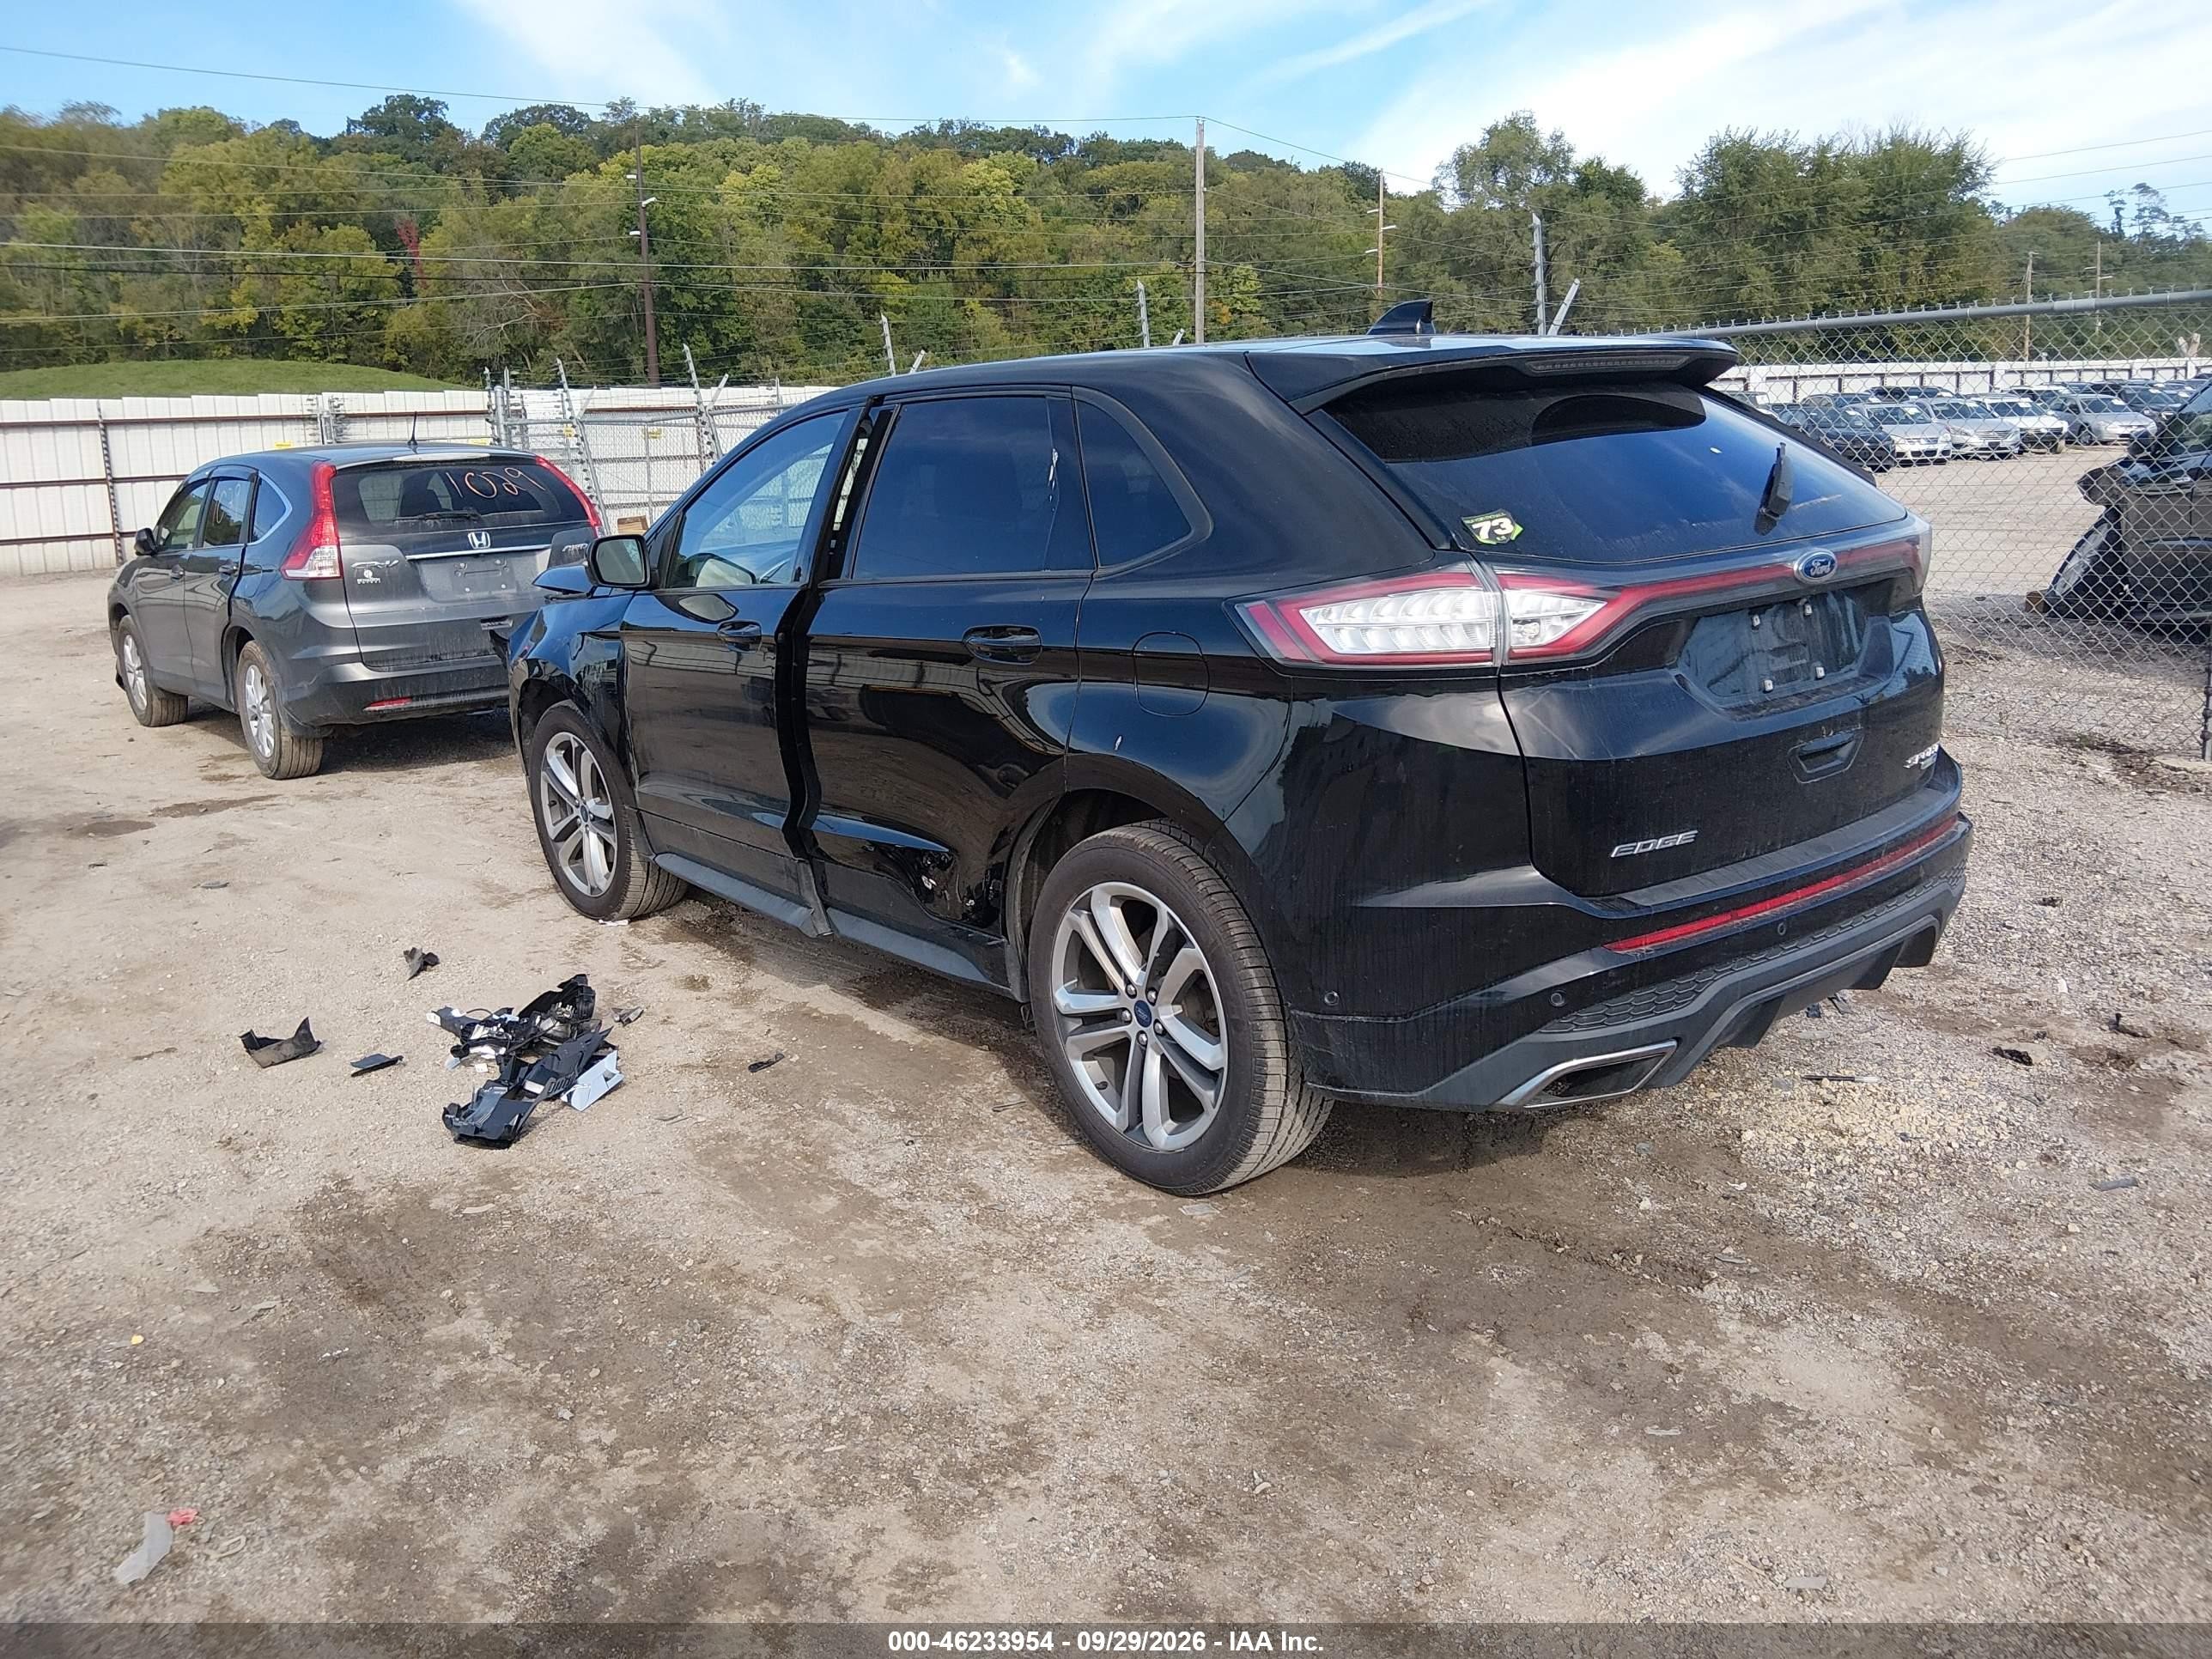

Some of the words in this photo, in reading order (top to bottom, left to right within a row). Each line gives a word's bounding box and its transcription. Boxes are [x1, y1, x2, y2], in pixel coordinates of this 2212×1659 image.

[445, 467, 547, 500] 1029
[1471, 517, 1515, 540] 73
[1610, 829, 1698, 858] EDGE
